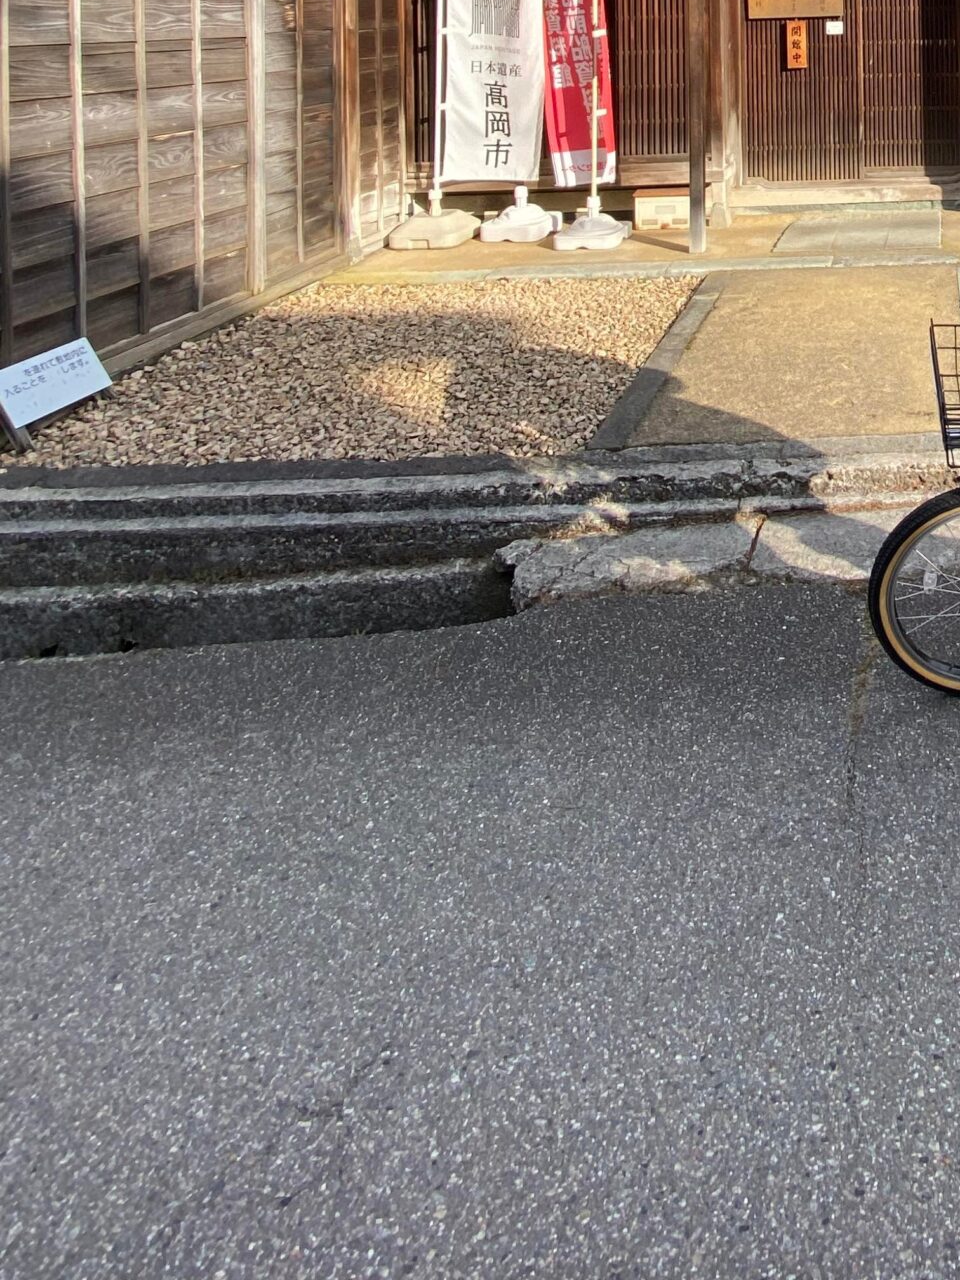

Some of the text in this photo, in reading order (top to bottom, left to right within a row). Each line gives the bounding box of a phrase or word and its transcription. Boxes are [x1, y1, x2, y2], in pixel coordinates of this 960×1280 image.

[471, 60, 523, 78] 日本遺産
[483, 81, 513, 169] 高岡市
[4, 375, 47, 398] 入ることを
